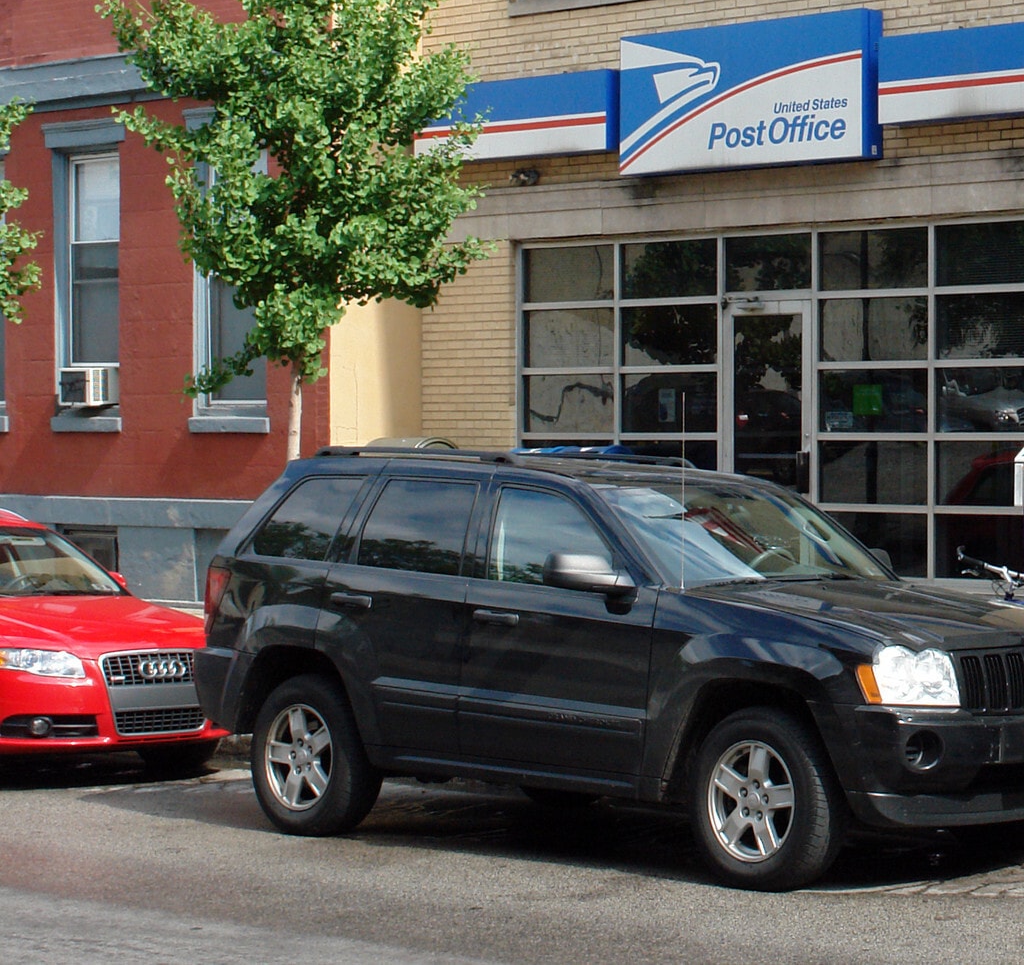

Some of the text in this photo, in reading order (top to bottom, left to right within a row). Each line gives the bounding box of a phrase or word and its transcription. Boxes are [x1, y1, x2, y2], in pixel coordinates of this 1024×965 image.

[774, 97, 848, 114] United States
[708, 114, 846, 150] Post Office
